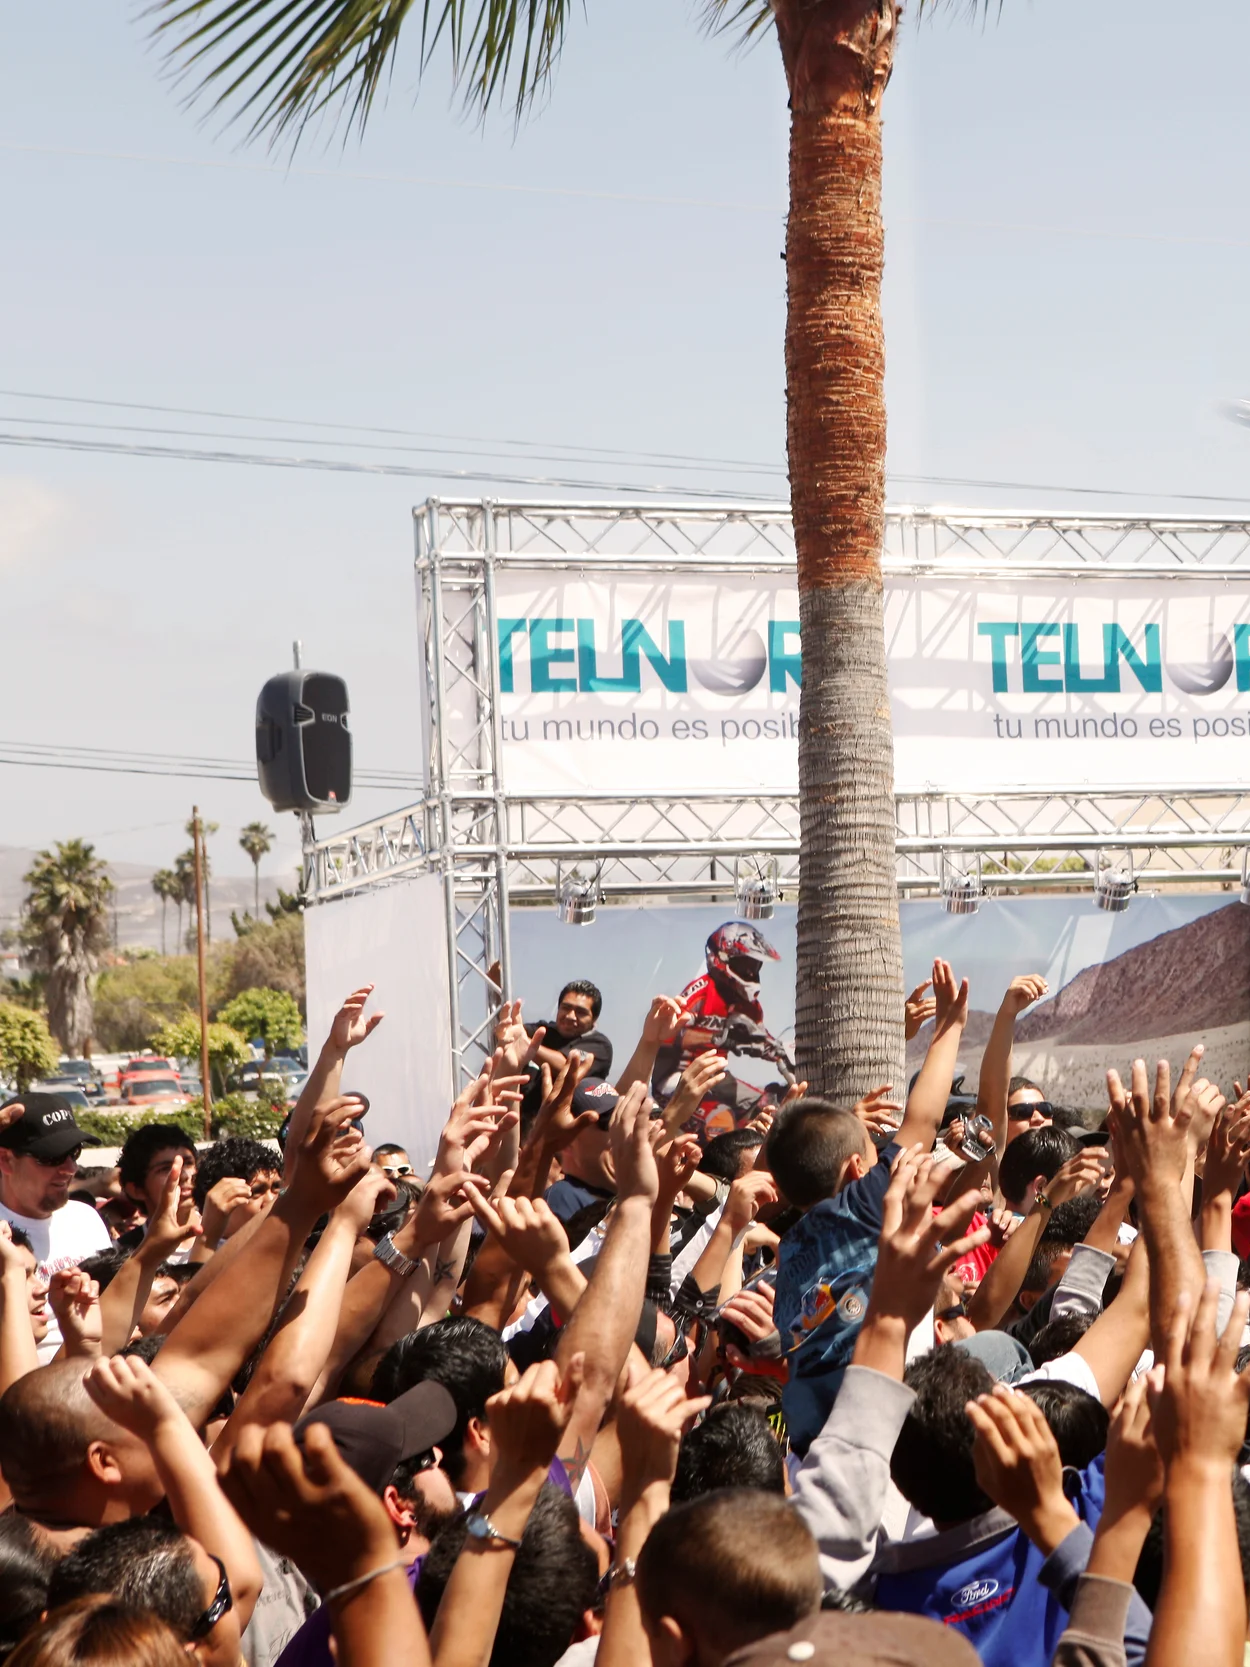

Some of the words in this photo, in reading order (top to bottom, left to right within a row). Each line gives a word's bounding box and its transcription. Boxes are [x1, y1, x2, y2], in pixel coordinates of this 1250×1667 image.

[501, 714, 529, 742] tu
[542, 711, 660, 741] mundo
[671, 719, 709, 741] es
[720, 711, 800, 747] posib
[993, 713, 1023, 739] tu
[1034, 711, 1138, 739] mundo
[1148, 717, 1183, 738] es
[961, 1580, 990, 1605] Ford
